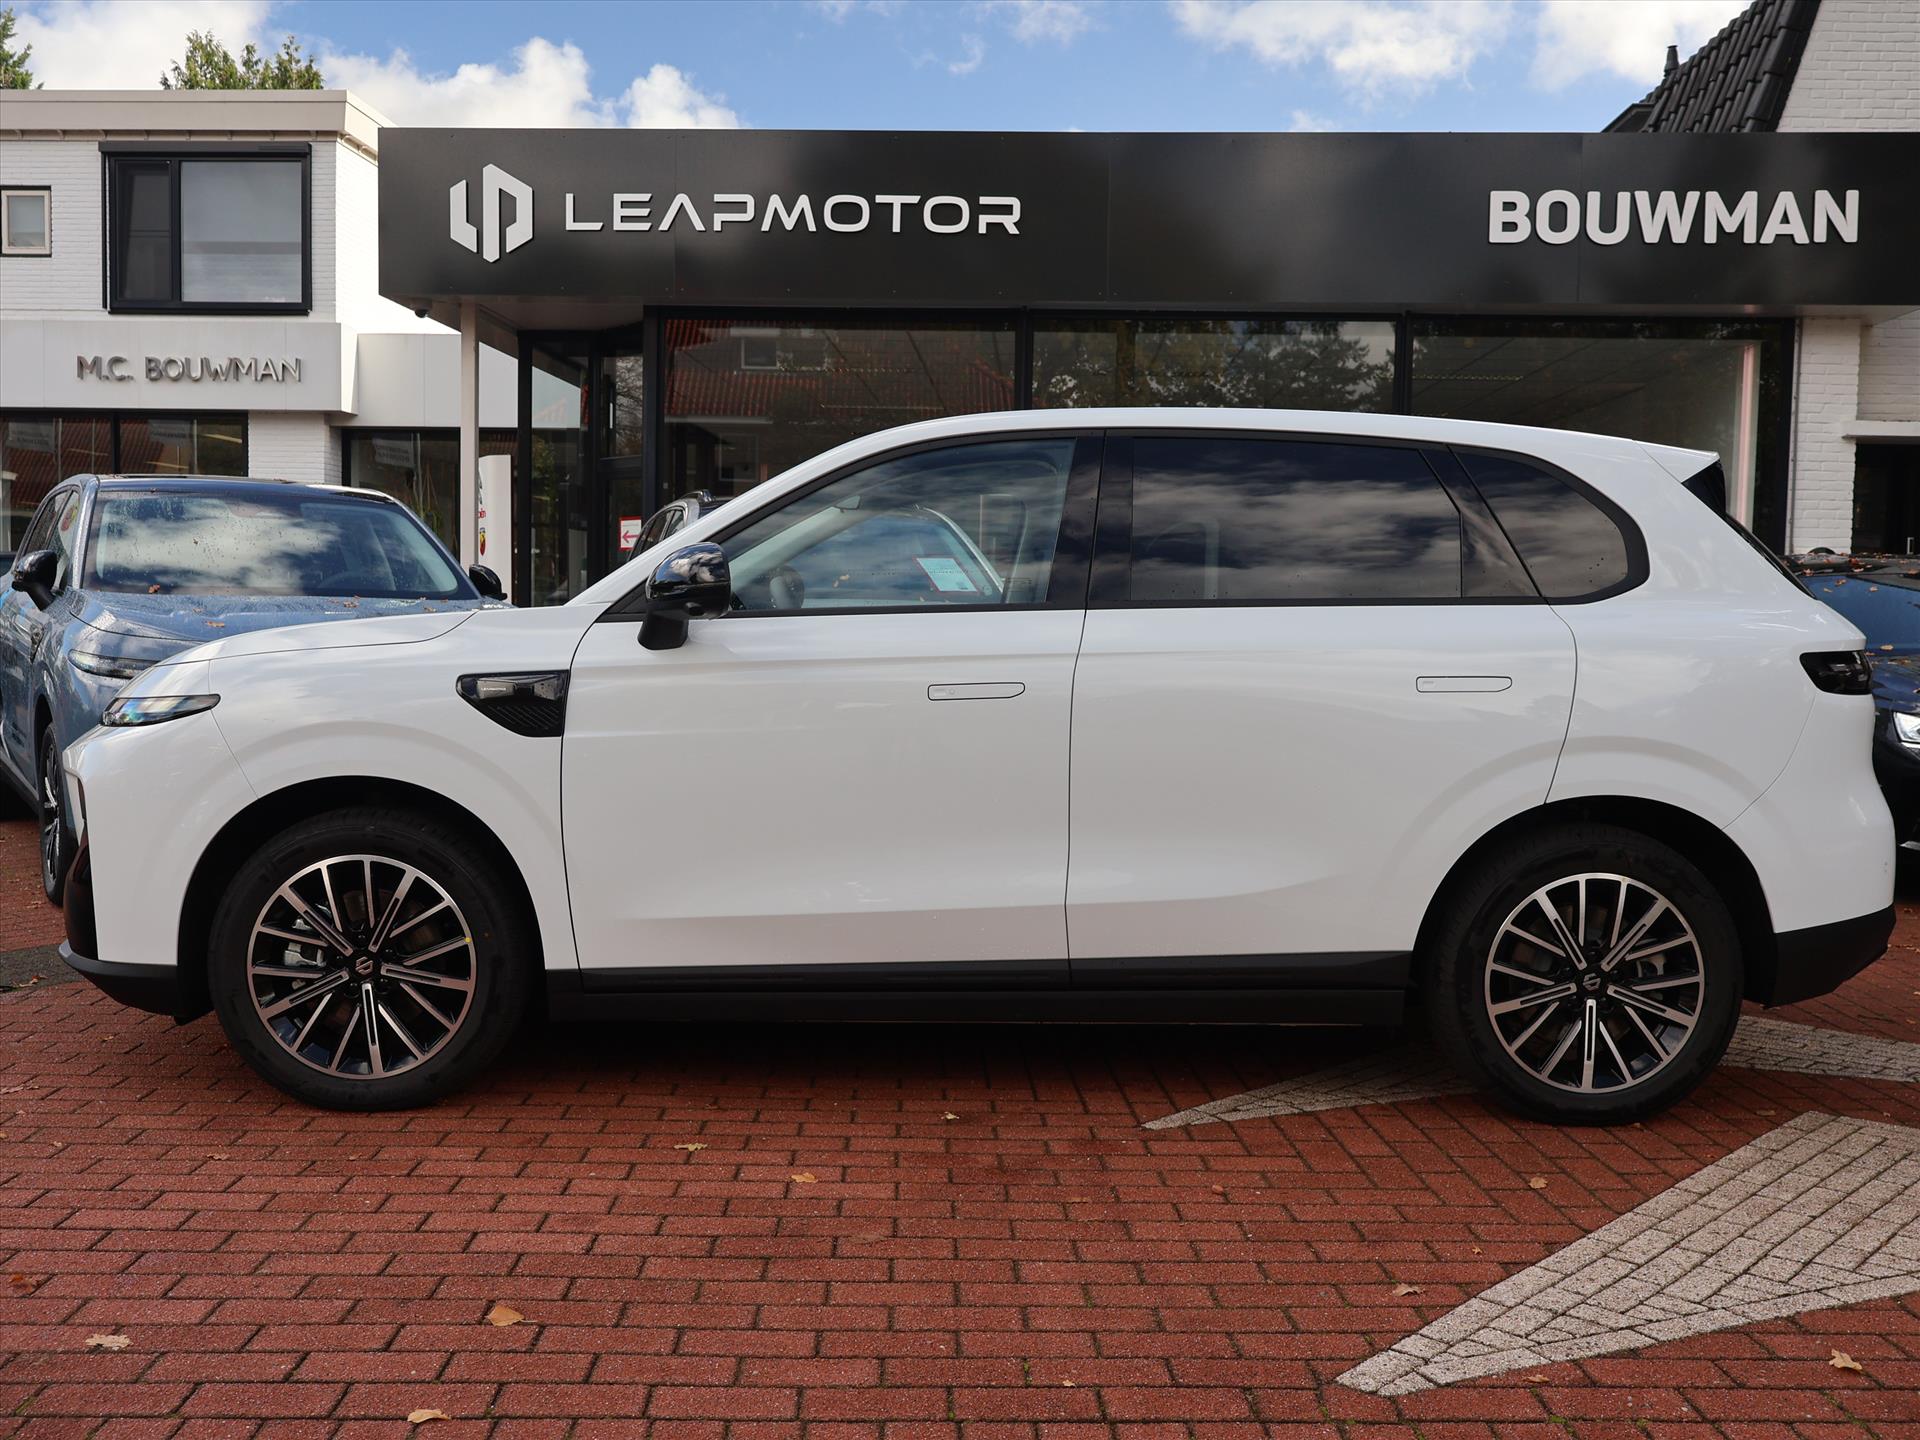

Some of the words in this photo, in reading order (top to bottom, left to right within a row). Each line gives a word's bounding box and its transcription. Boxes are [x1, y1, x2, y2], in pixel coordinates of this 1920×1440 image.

[564, 192, 1021, 236] LEAPMOTOR
[1488, 189, 1860, 246] BOUWMAN
[76, 355, 135, 382] M.C.
[144, 356, 302, 383] BOUWMAN
